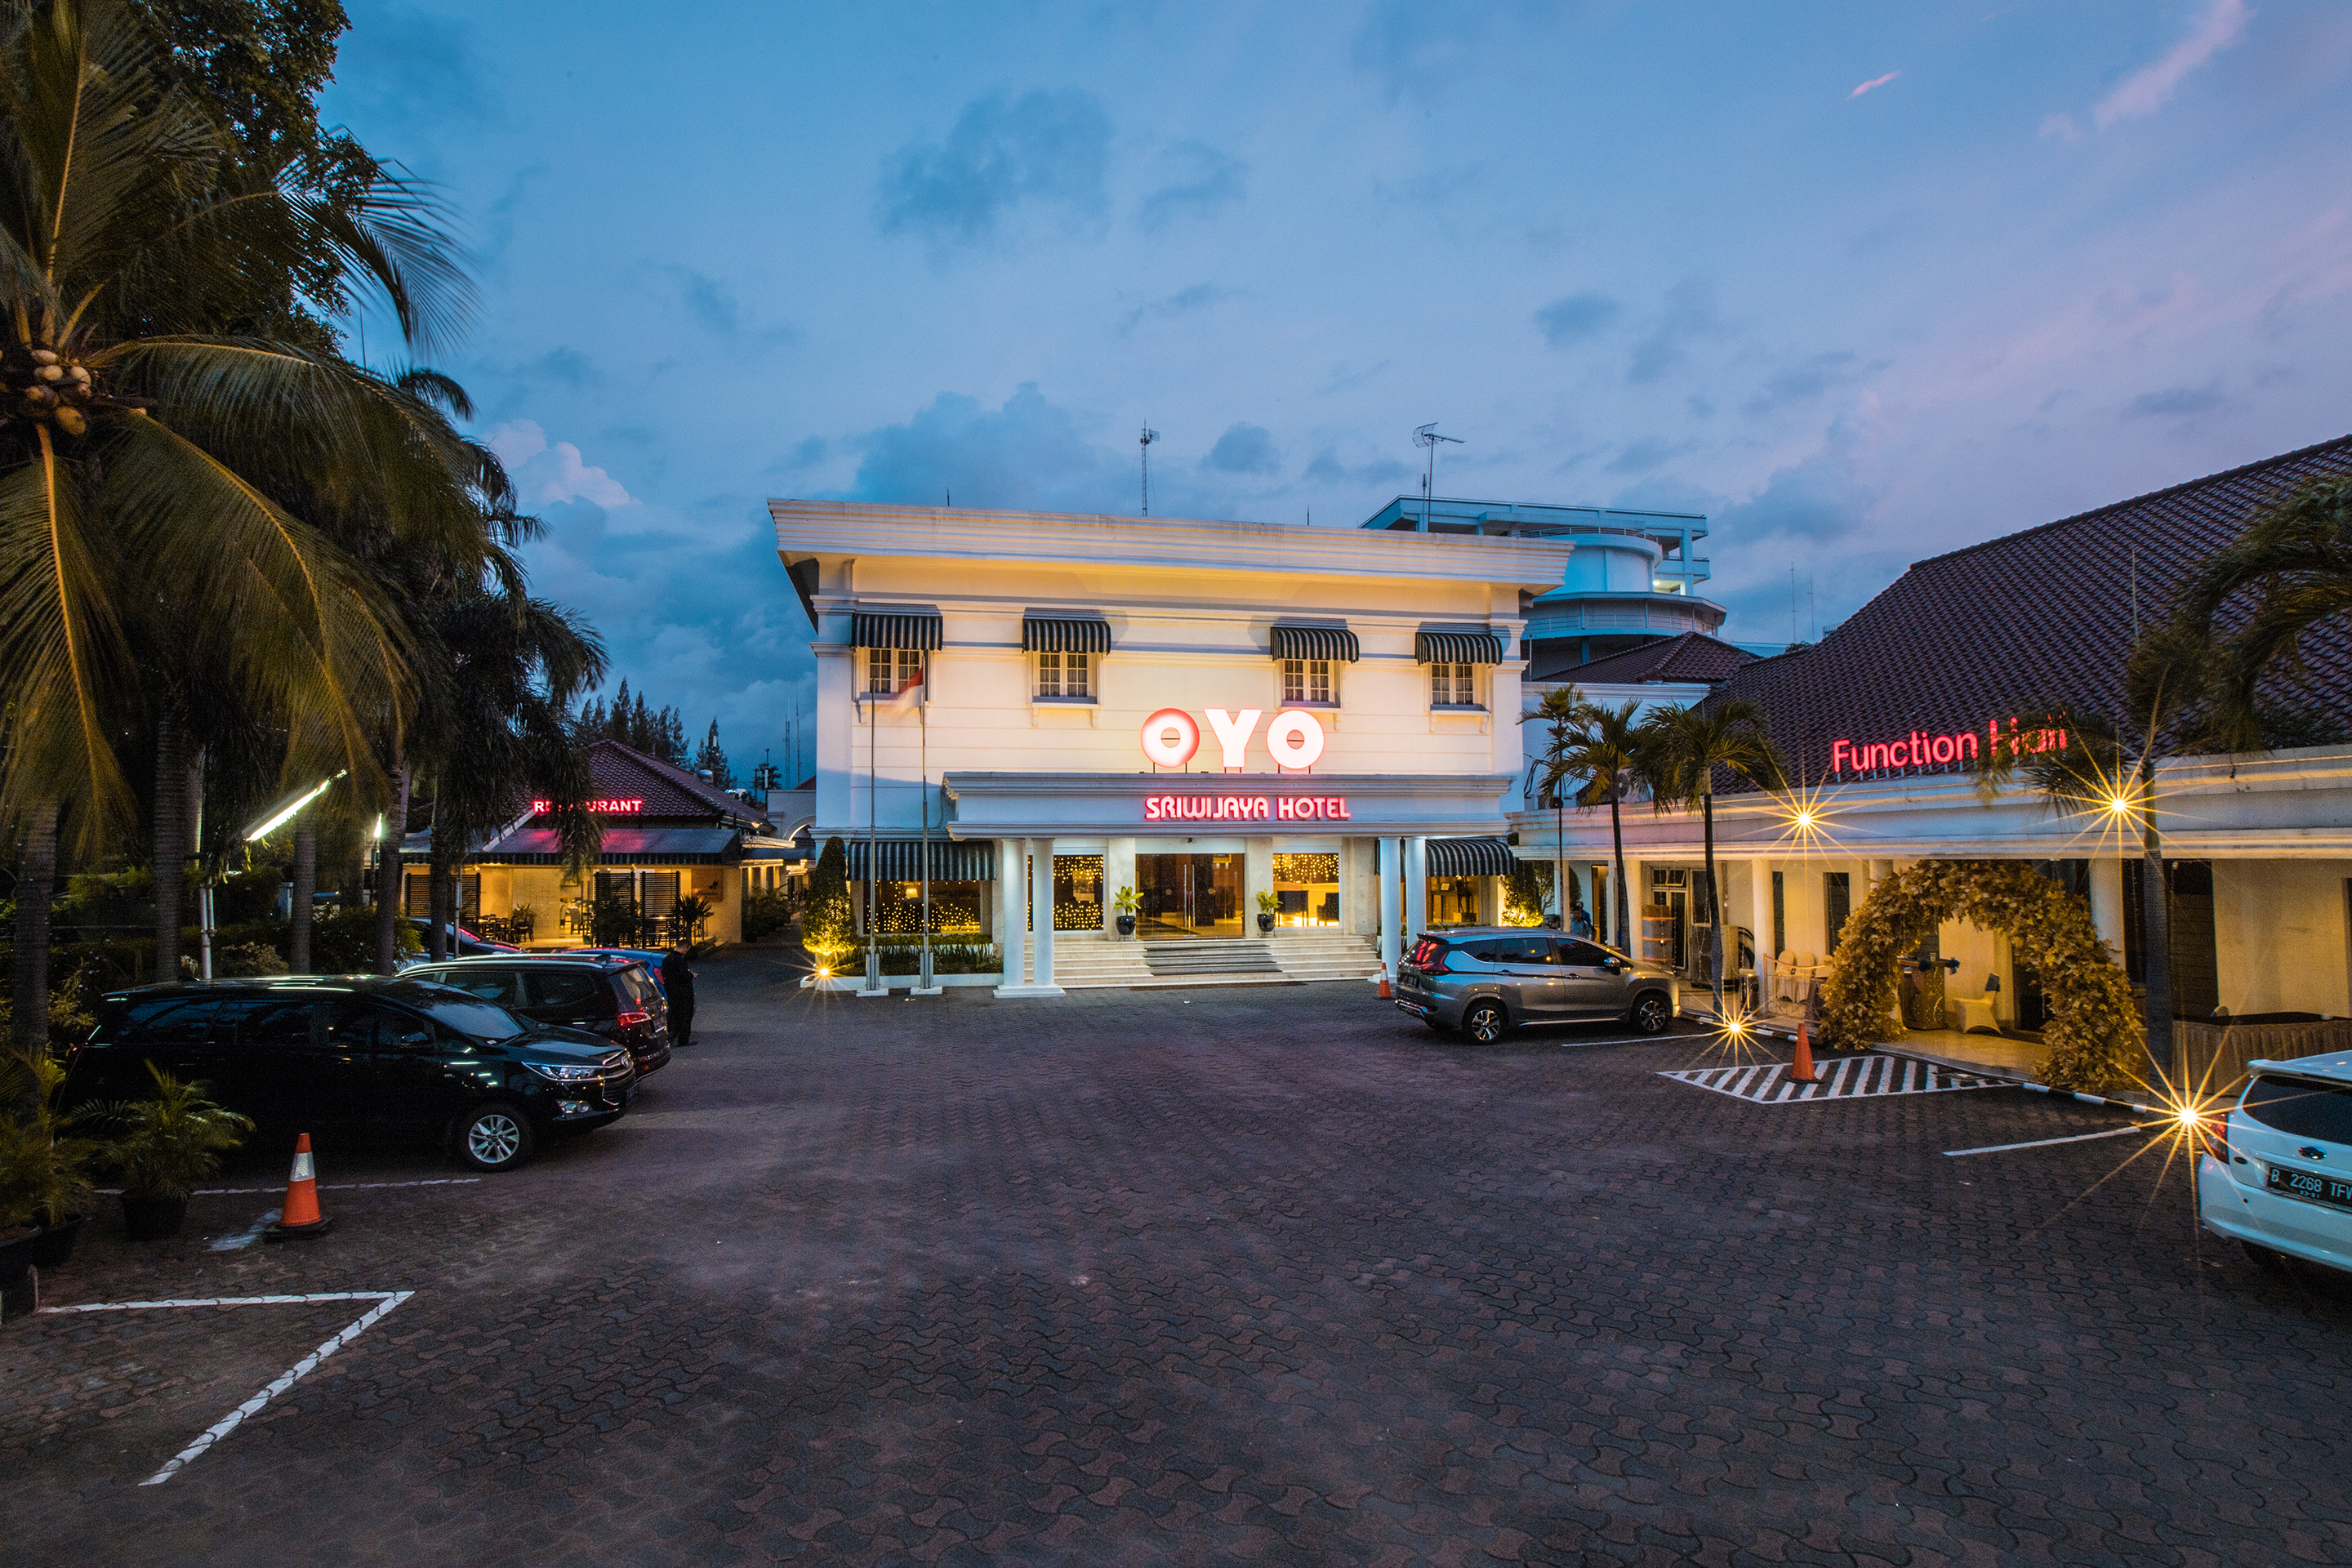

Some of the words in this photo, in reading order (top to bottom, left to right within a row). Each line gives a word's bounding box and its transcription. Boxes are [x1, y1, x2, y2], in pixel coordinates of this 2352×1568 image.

[1141, 708, 1325, 769] OYO
[1833, 730, 1978, 773] Function
[1144, 795, 1269, 819] SRIWIJAYA
[1277, 796, 1352, 819] HOTEL
[2270, 1169, 2280, 1183] B
[2289, 1174, 2323, 1192] 2268
